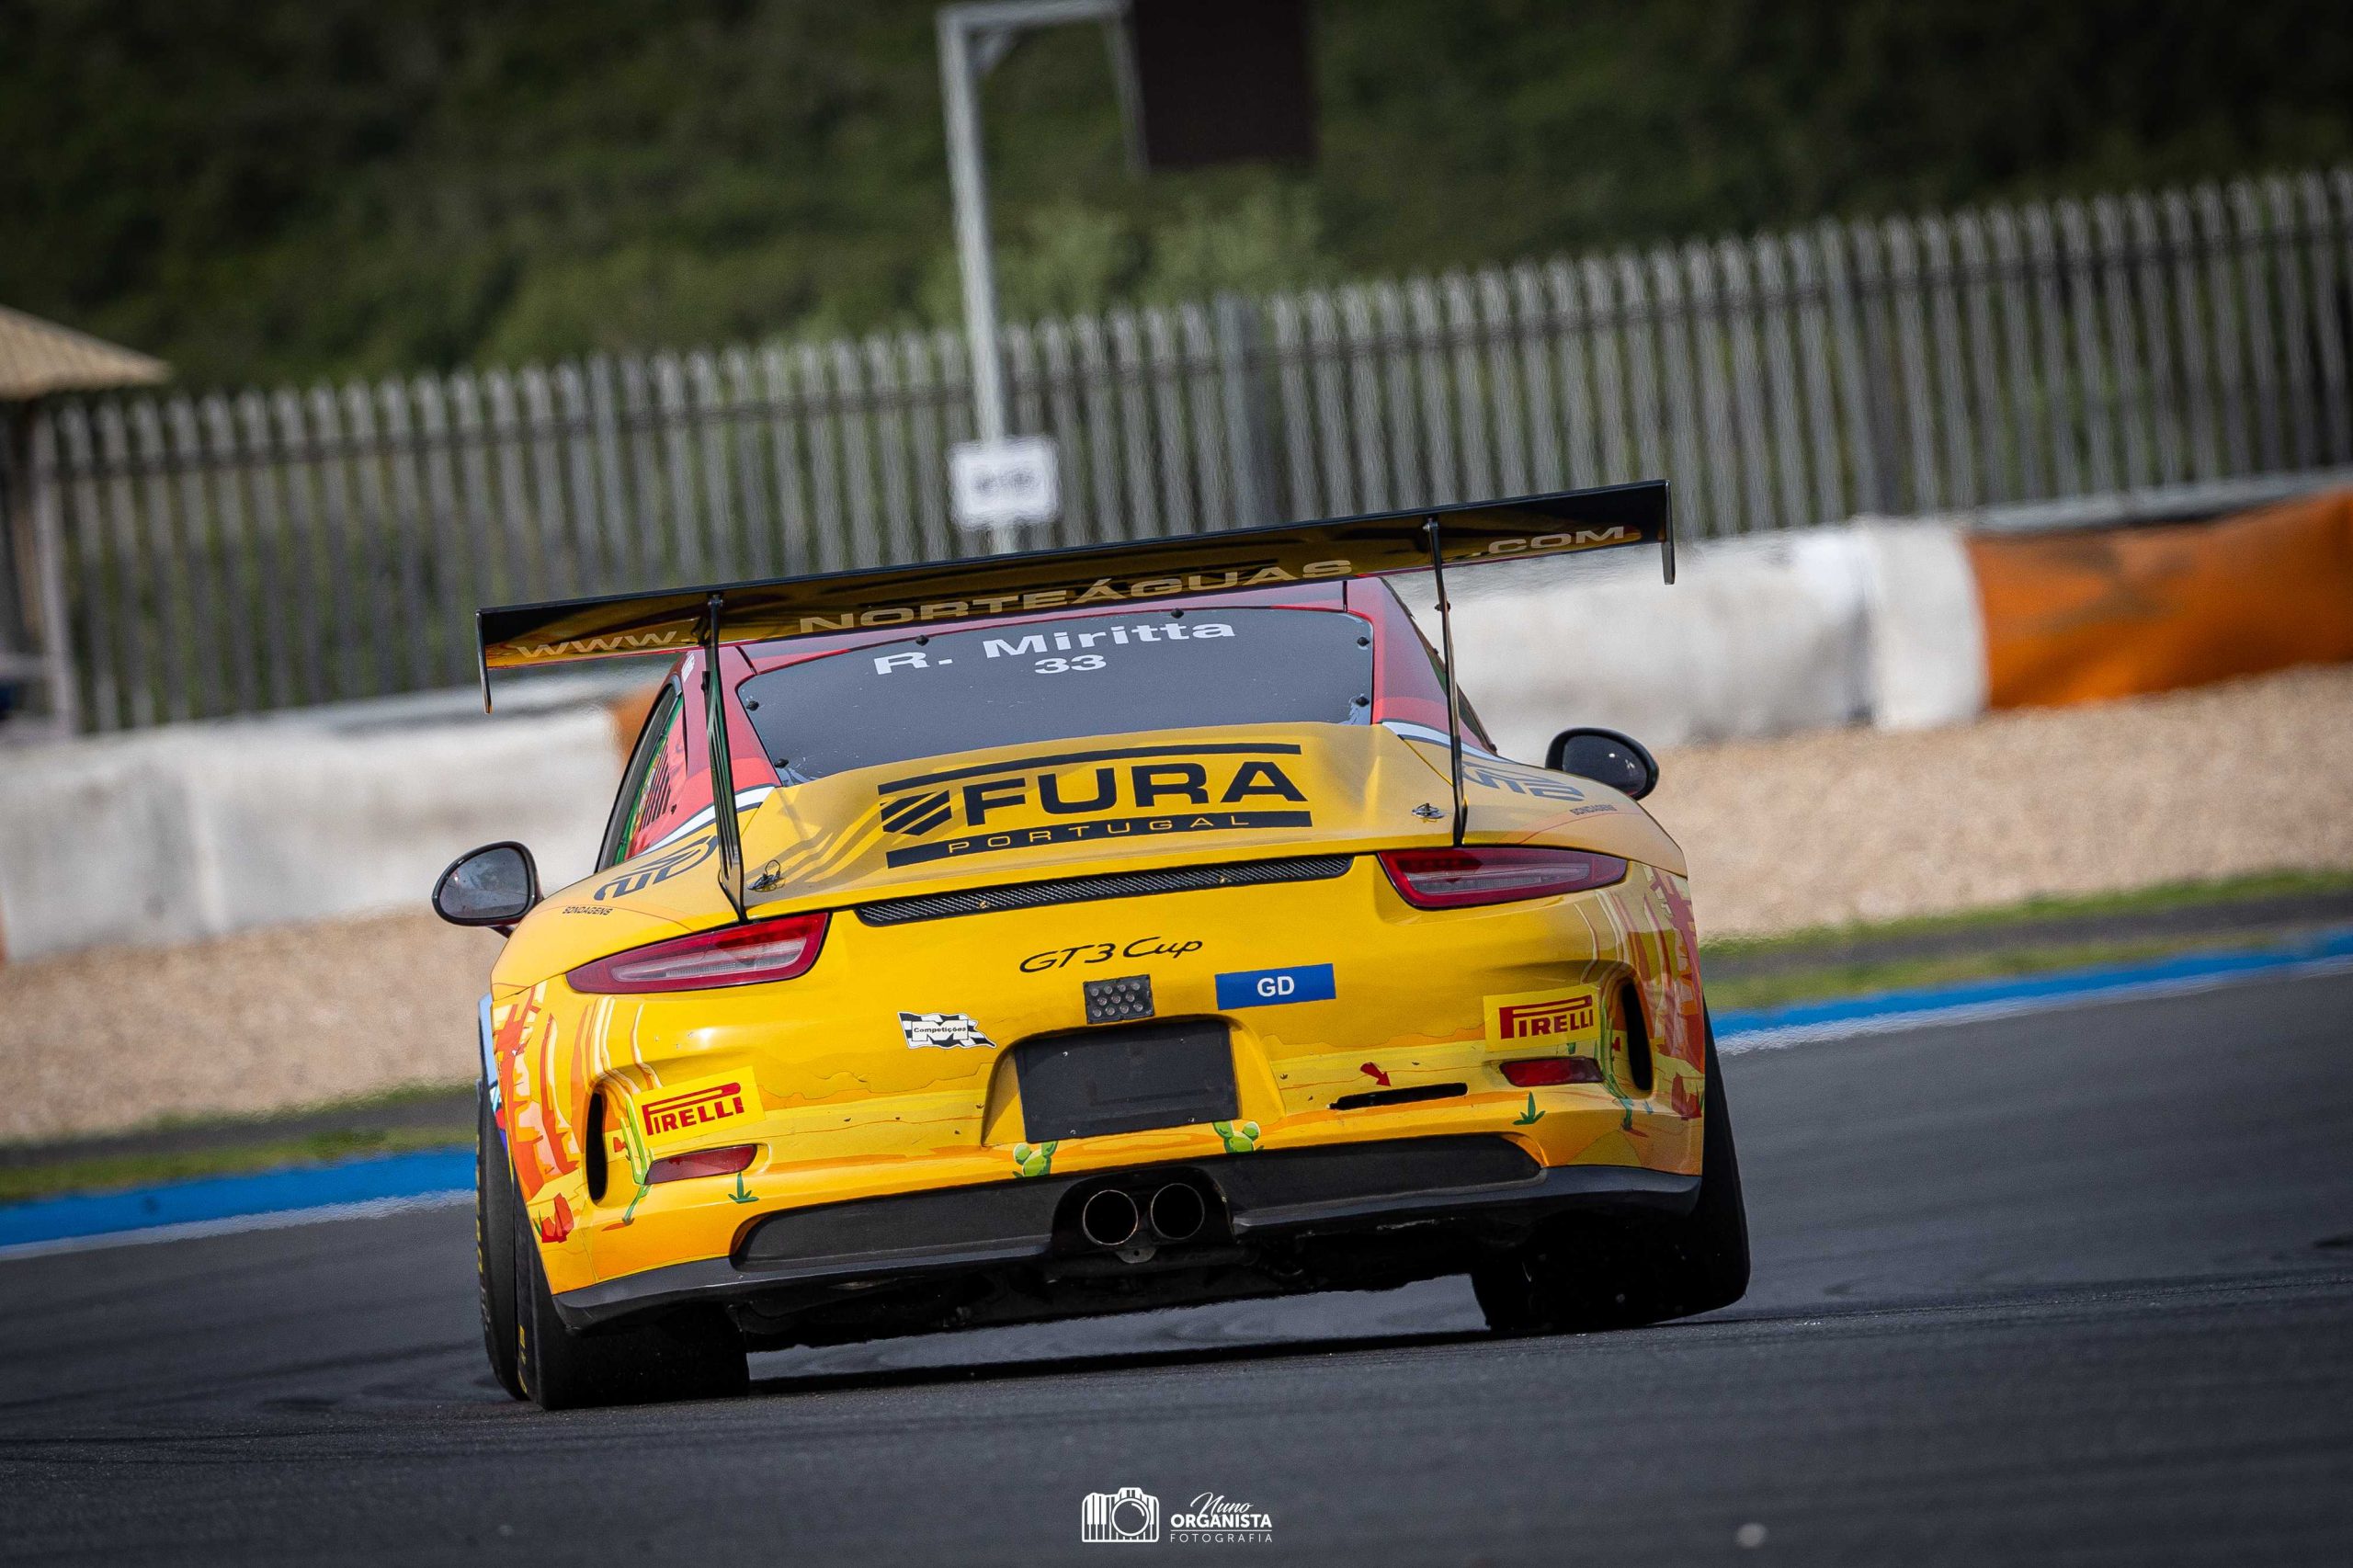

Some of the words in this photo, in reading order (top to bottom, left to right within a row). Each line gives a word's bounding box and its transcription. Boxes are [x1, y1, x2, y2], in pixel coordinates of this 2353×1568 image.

[799, 559, 1353, 633] NORTEÁGUAS
[873, 651, 953, 676] R.
[982, 621, 1235, 659] Miritta
[1034, 653, 1107, 675] 33
[961, 760, 1308, 827] FURA
[948, 814, 1250, 855] PORTUGAL
[1018, 942, 1117, 973] GT3
[1122, 936, 1203, 959] Cup
[1256, 975, 1295, 997] GD
[914, 1026, 967, 1034] Competições
[1498, 994, 1594, 1040] PIRELLI
[642, 1082, 745, 1136] PIRELLI
